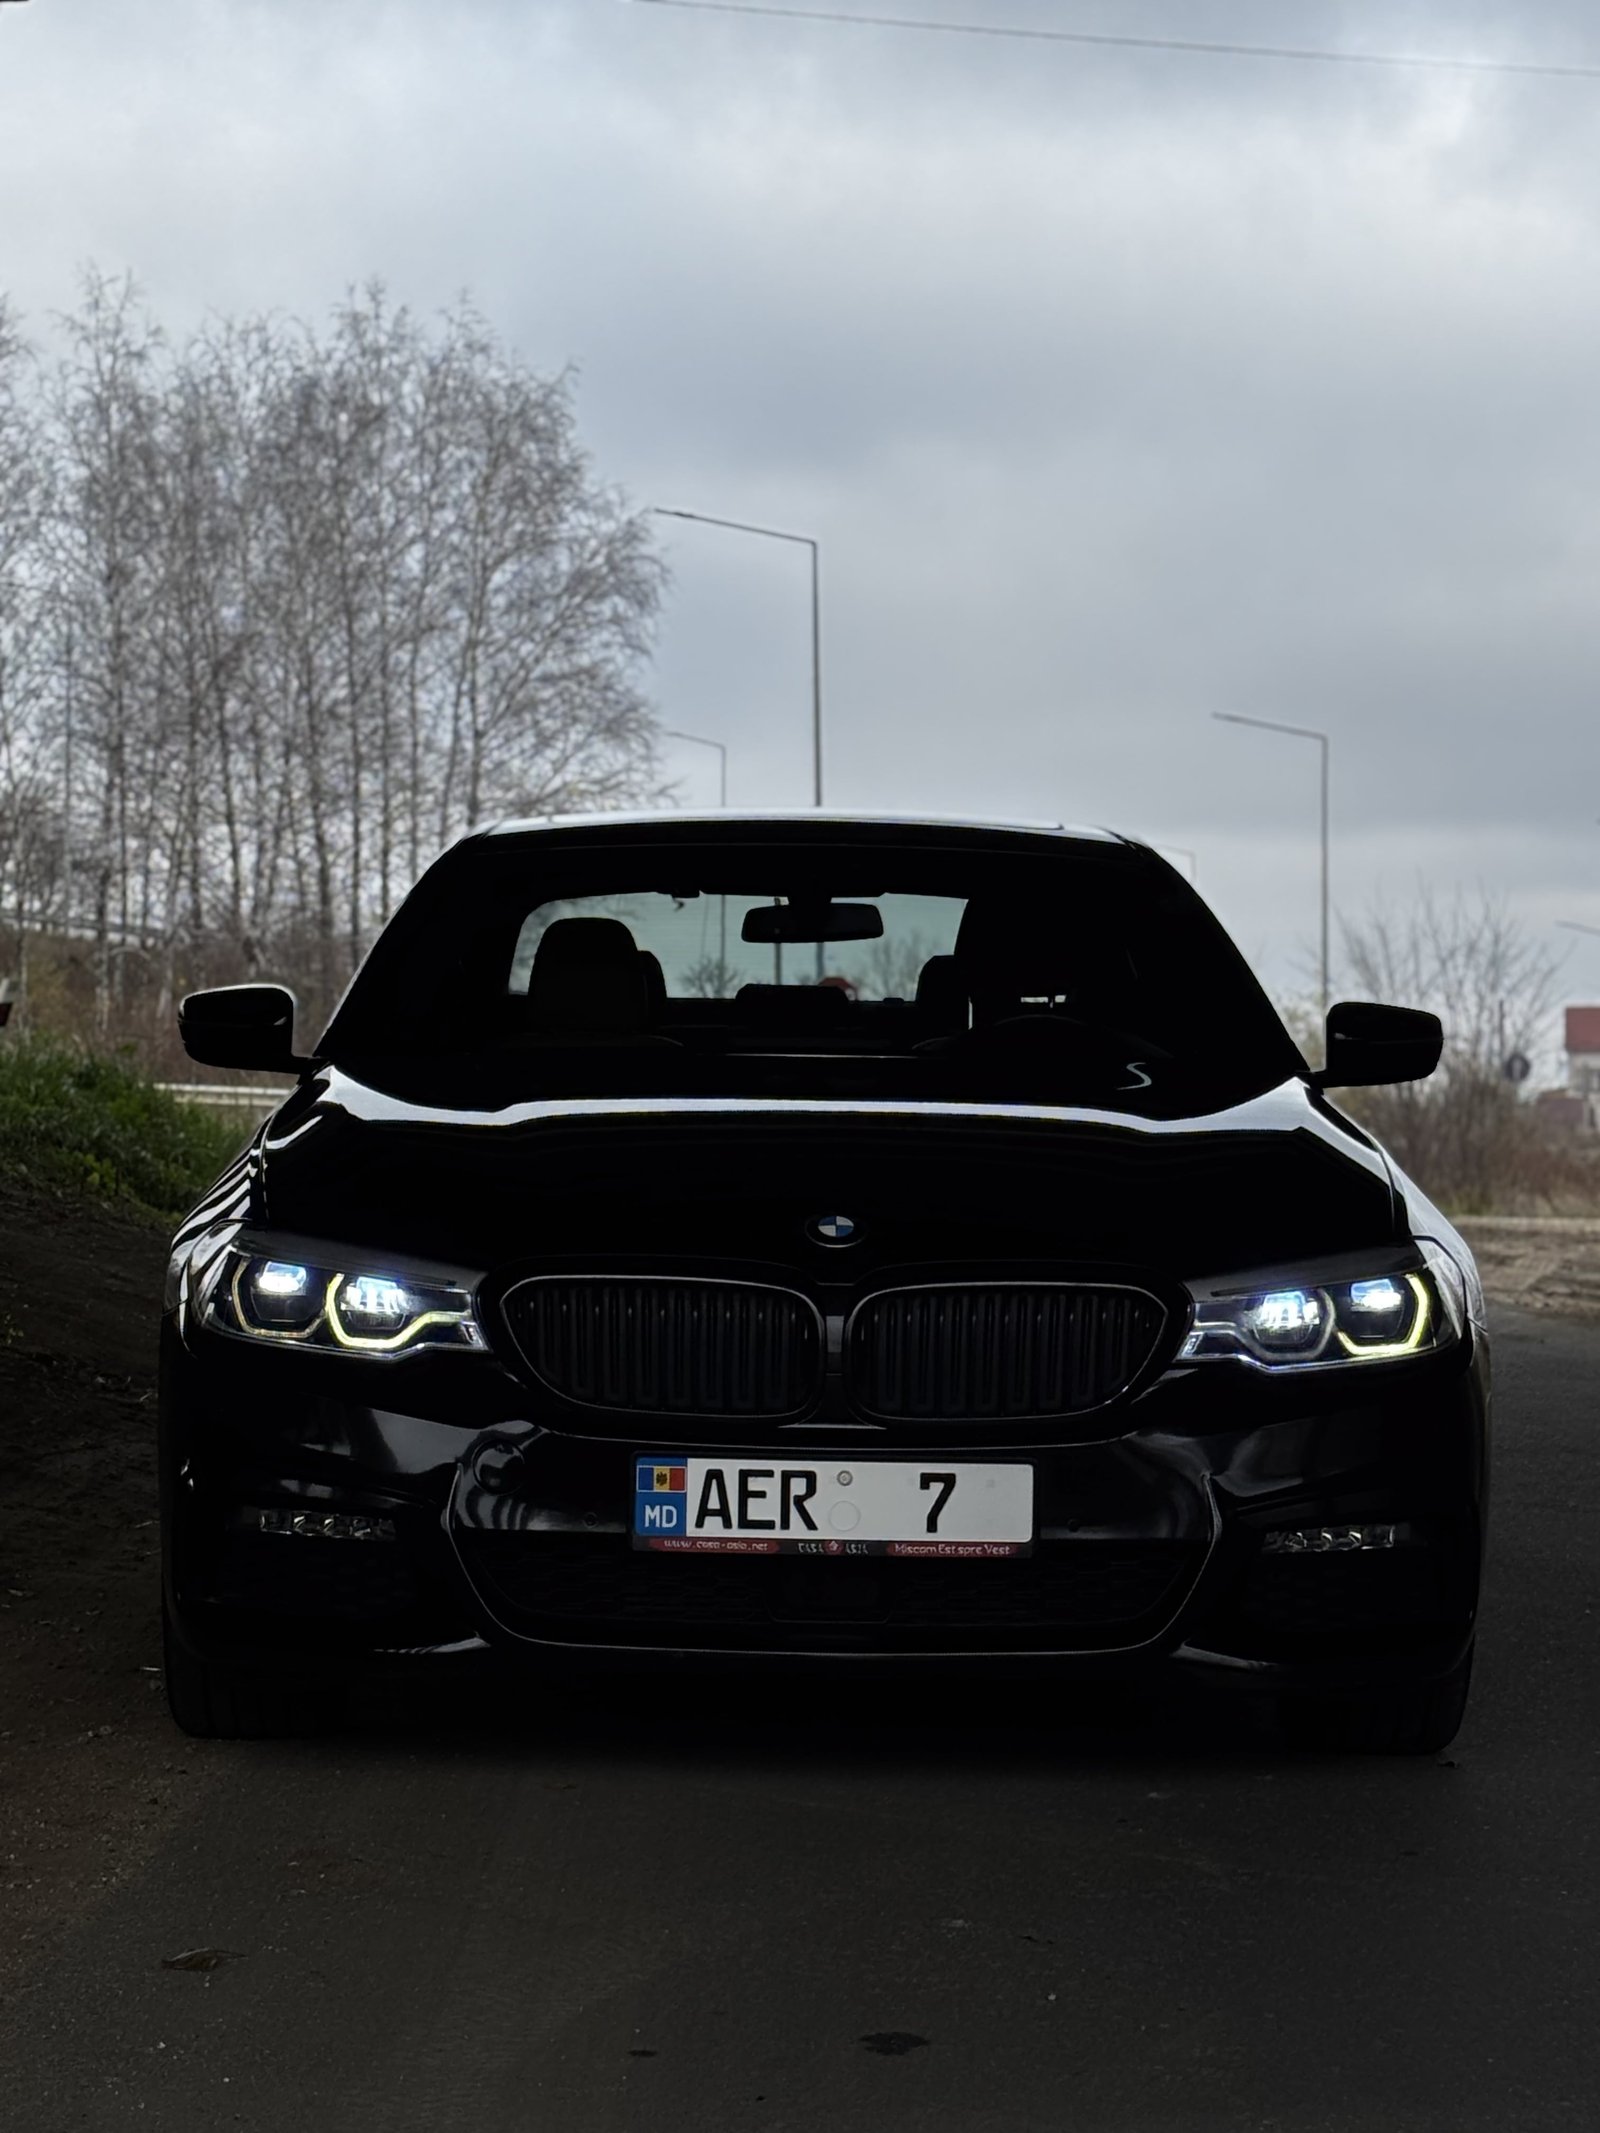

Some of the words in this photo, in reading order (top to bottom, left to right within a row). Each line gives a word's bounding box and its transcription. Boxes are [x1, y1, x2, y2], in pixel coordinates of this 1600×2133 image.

[694, 1468, 818, 1531] AER
[919, 1473, 957, 1533] 7
[644, 1505, 678, 1529] MD
[984, 1544, 1011, 1555] Vest
